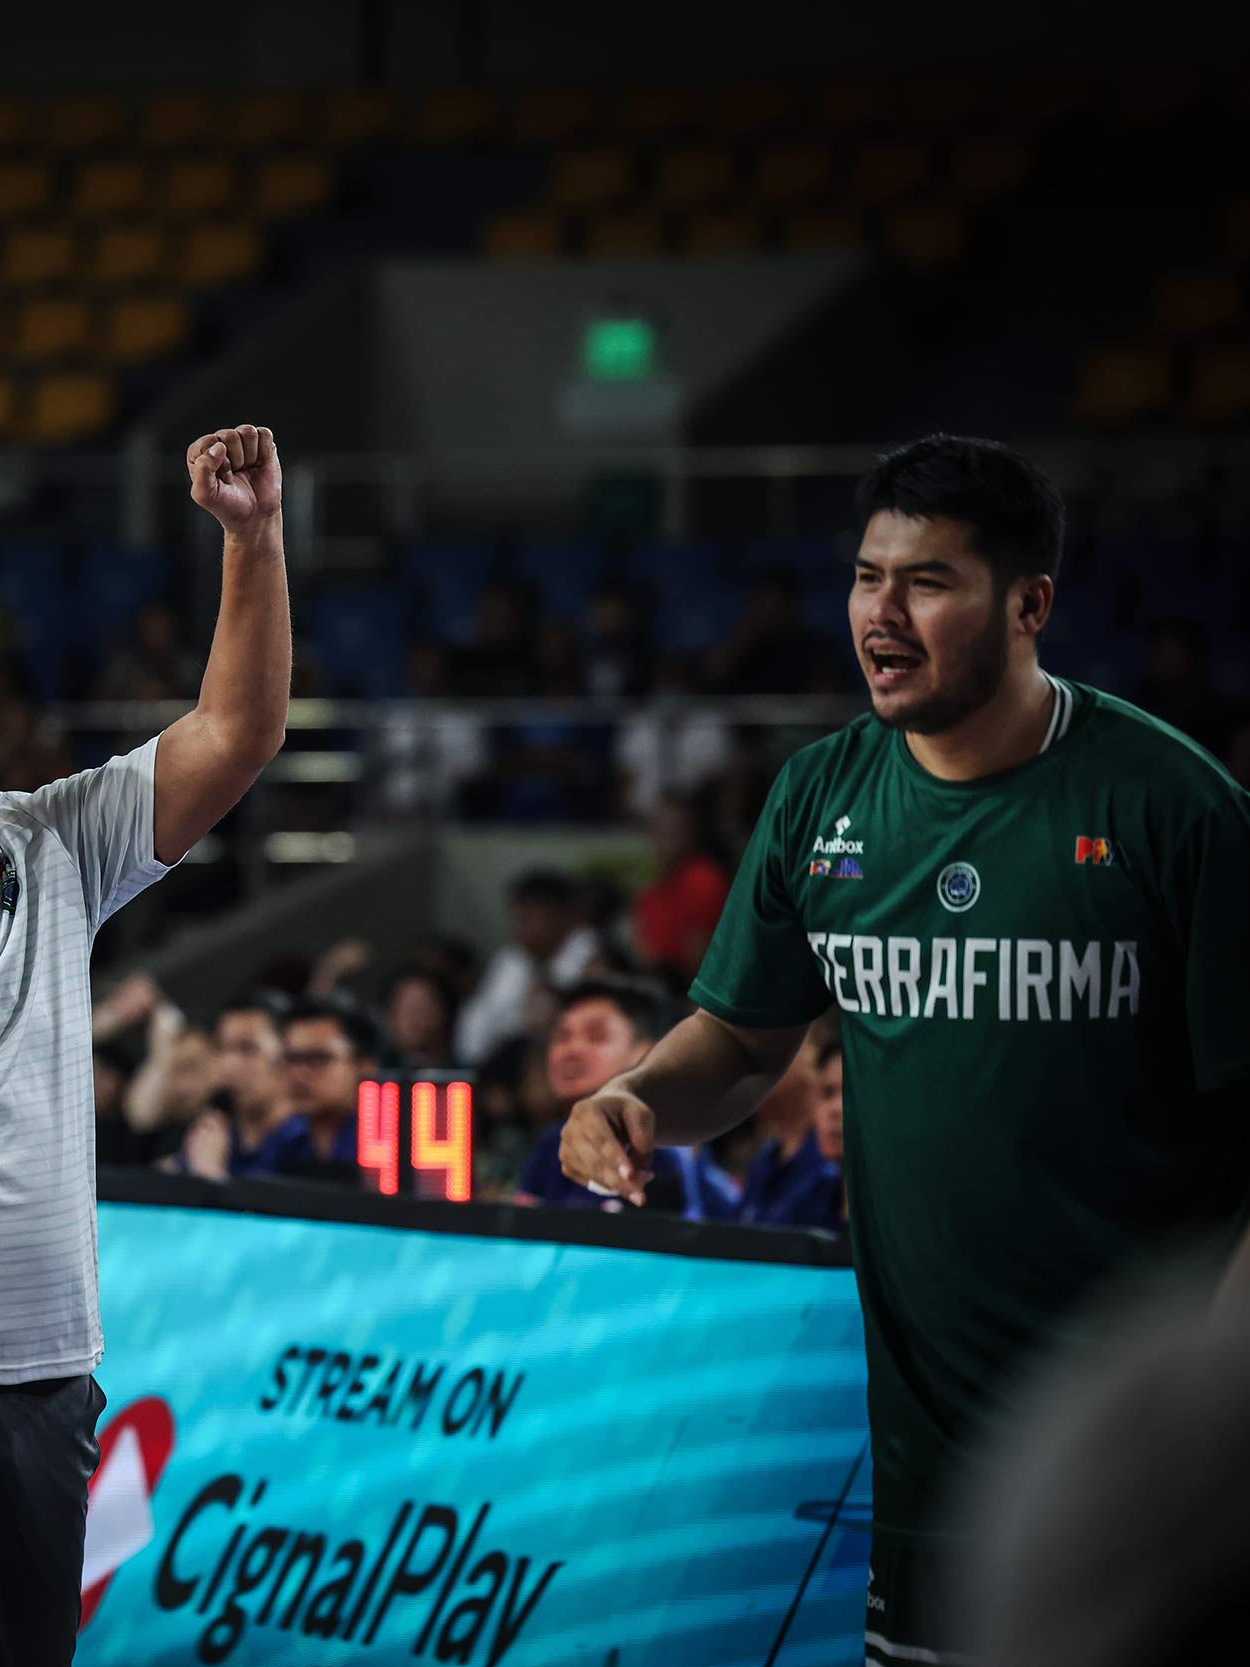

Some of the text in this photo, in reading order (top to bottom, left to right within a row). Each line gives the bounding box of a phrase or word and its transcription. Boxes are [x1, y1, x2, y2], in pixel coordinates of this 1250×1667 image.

[807, 931, 1141, 1021] TERRAFIRMA
[260, 1346, 526, 1439] STREAM ON
[155, 1474, 567, 1667] CignalPlay
